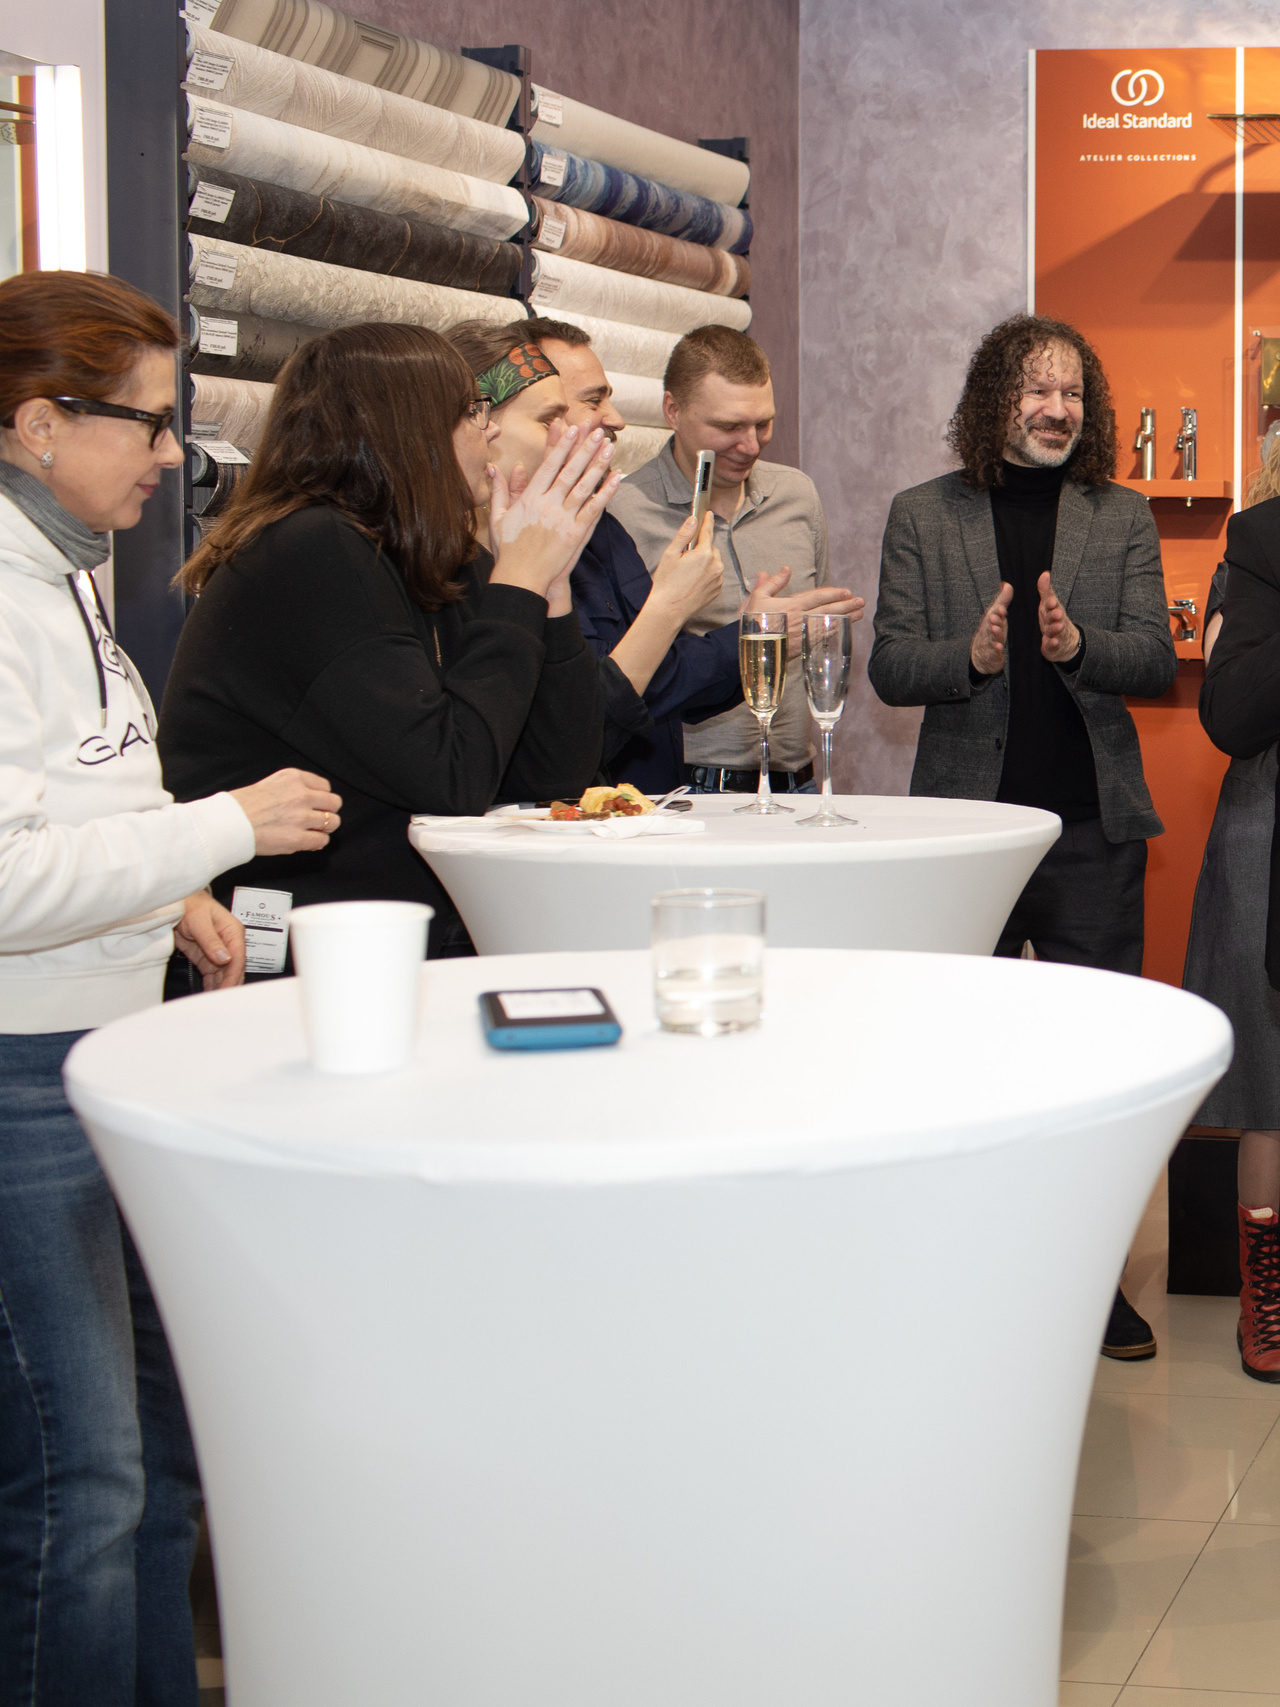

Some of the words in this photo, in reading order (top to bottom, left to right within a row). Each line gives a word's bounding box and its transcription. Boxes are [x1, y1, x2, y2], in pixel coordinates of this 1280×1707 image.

[1082, 113, 1120, 129] Ideal
[1122, 112, 1192, 129] Standard
[1079, 154, 1123, 162] ATELIER
